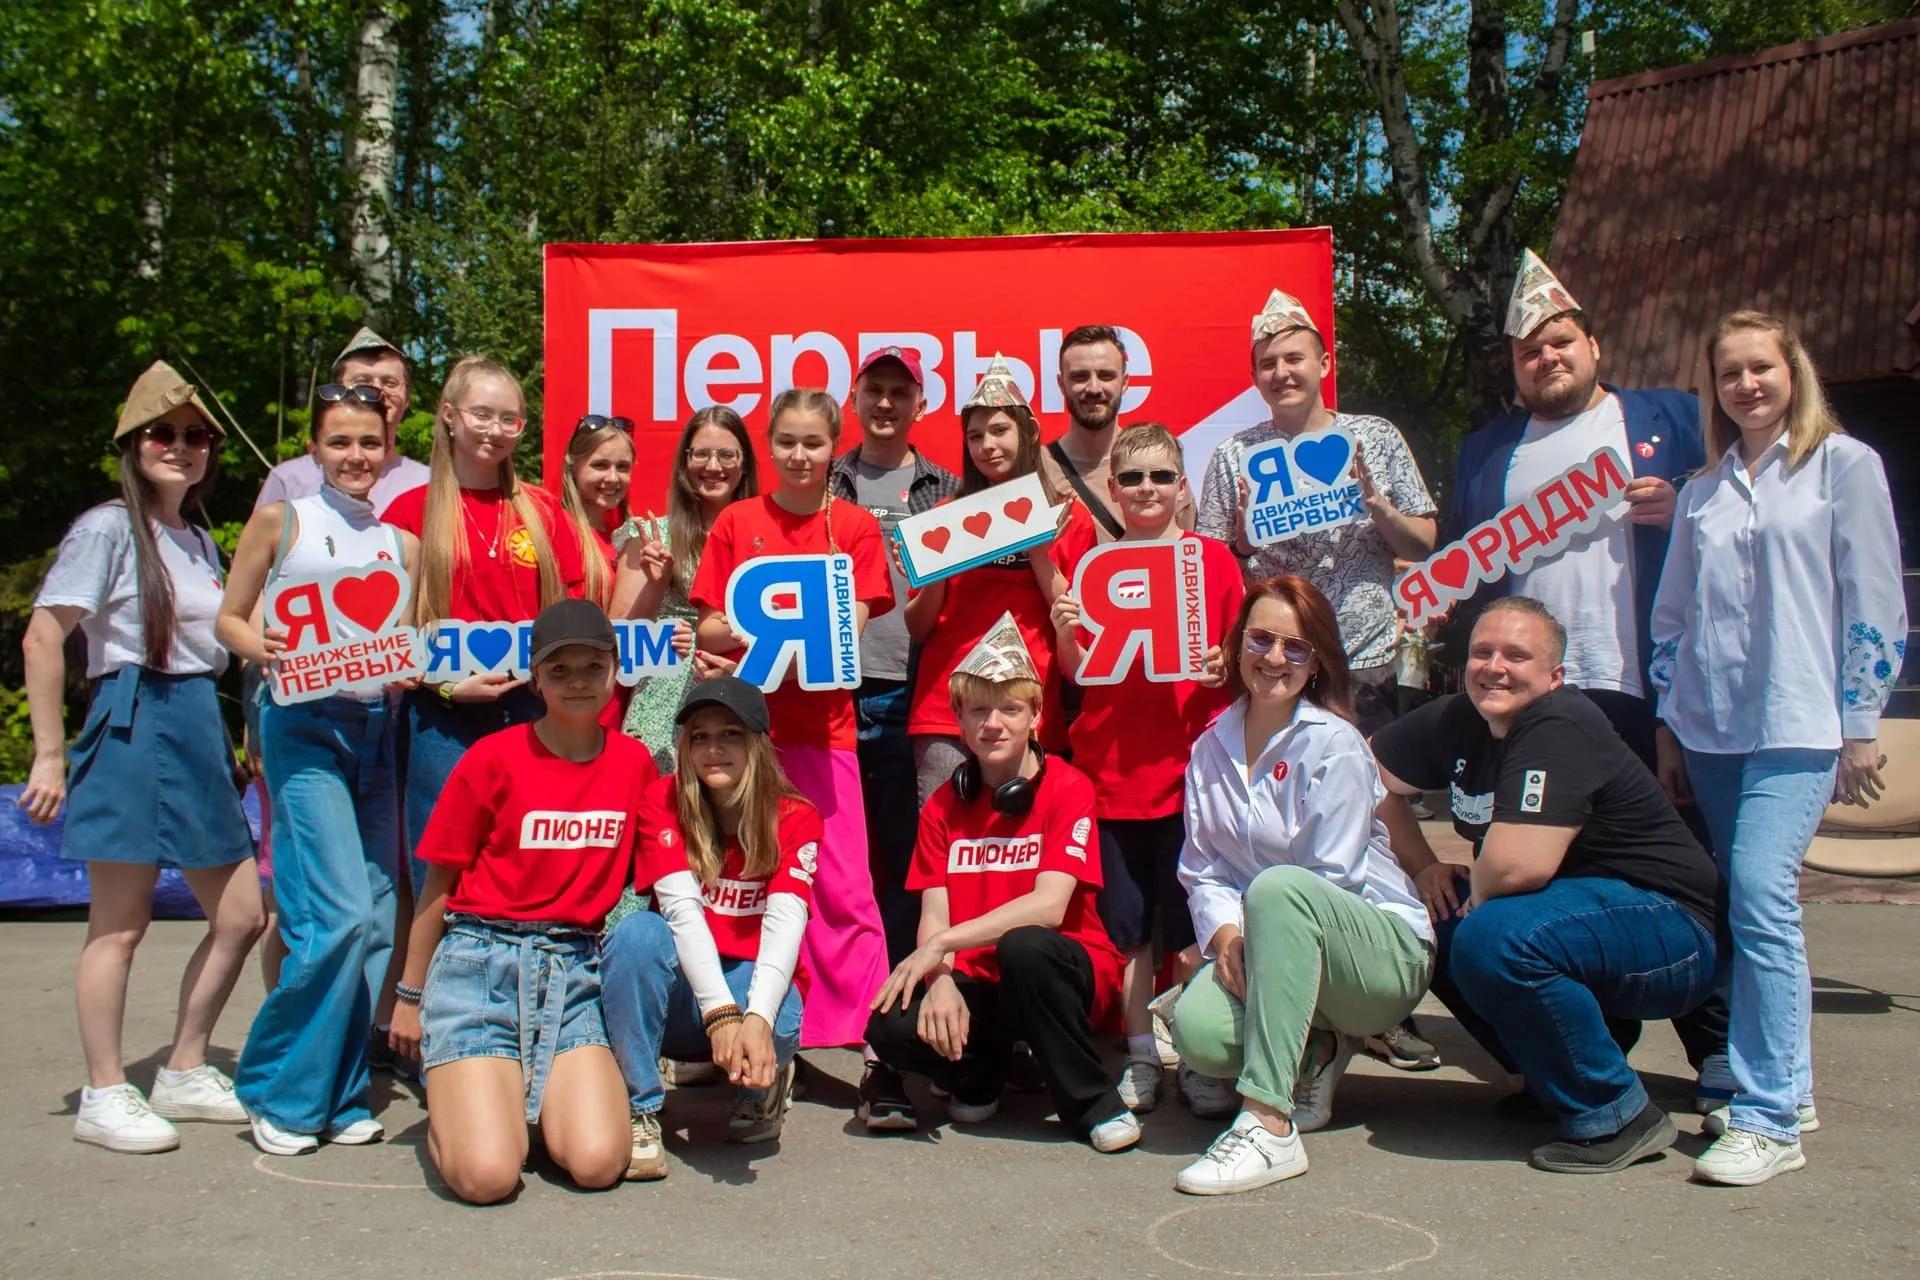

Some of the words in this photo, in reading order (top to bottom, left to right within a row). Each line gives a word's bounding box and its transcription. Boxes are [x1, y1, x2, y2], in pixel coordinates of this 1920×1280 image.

[588, 308, 1152, 419] Первые
[1248, 446, 1294, 504] Я
[1252, 484, 1359, 523] ДВИЖЕНИЕ
[1254, 497, 1364, 540] ПЕРВЫХ
[1183, 543, 1197, 556] В
[1400, 570, 1439, 619] Я
[1467, 452, 1626, 573] РДДМ
[834, 559, 847, 571] В
[274, 582, 332, 653] Я
[733, 560, 835, 687] Я
[833, 574, 856, 683] ДВИЖЕНИИ
[1080, 545, 1182, 678] Я
[1182, 560, 1203, 673] ДВИЖЕНИИ
[279, 633, 410, 678] ДВИЖЕНИЕ
[280, 650, 416, 697] ПЕРВЫХ
[427, 628, 461, 672] Я
[957, 841, 1039, 866] ПИОНЕР
